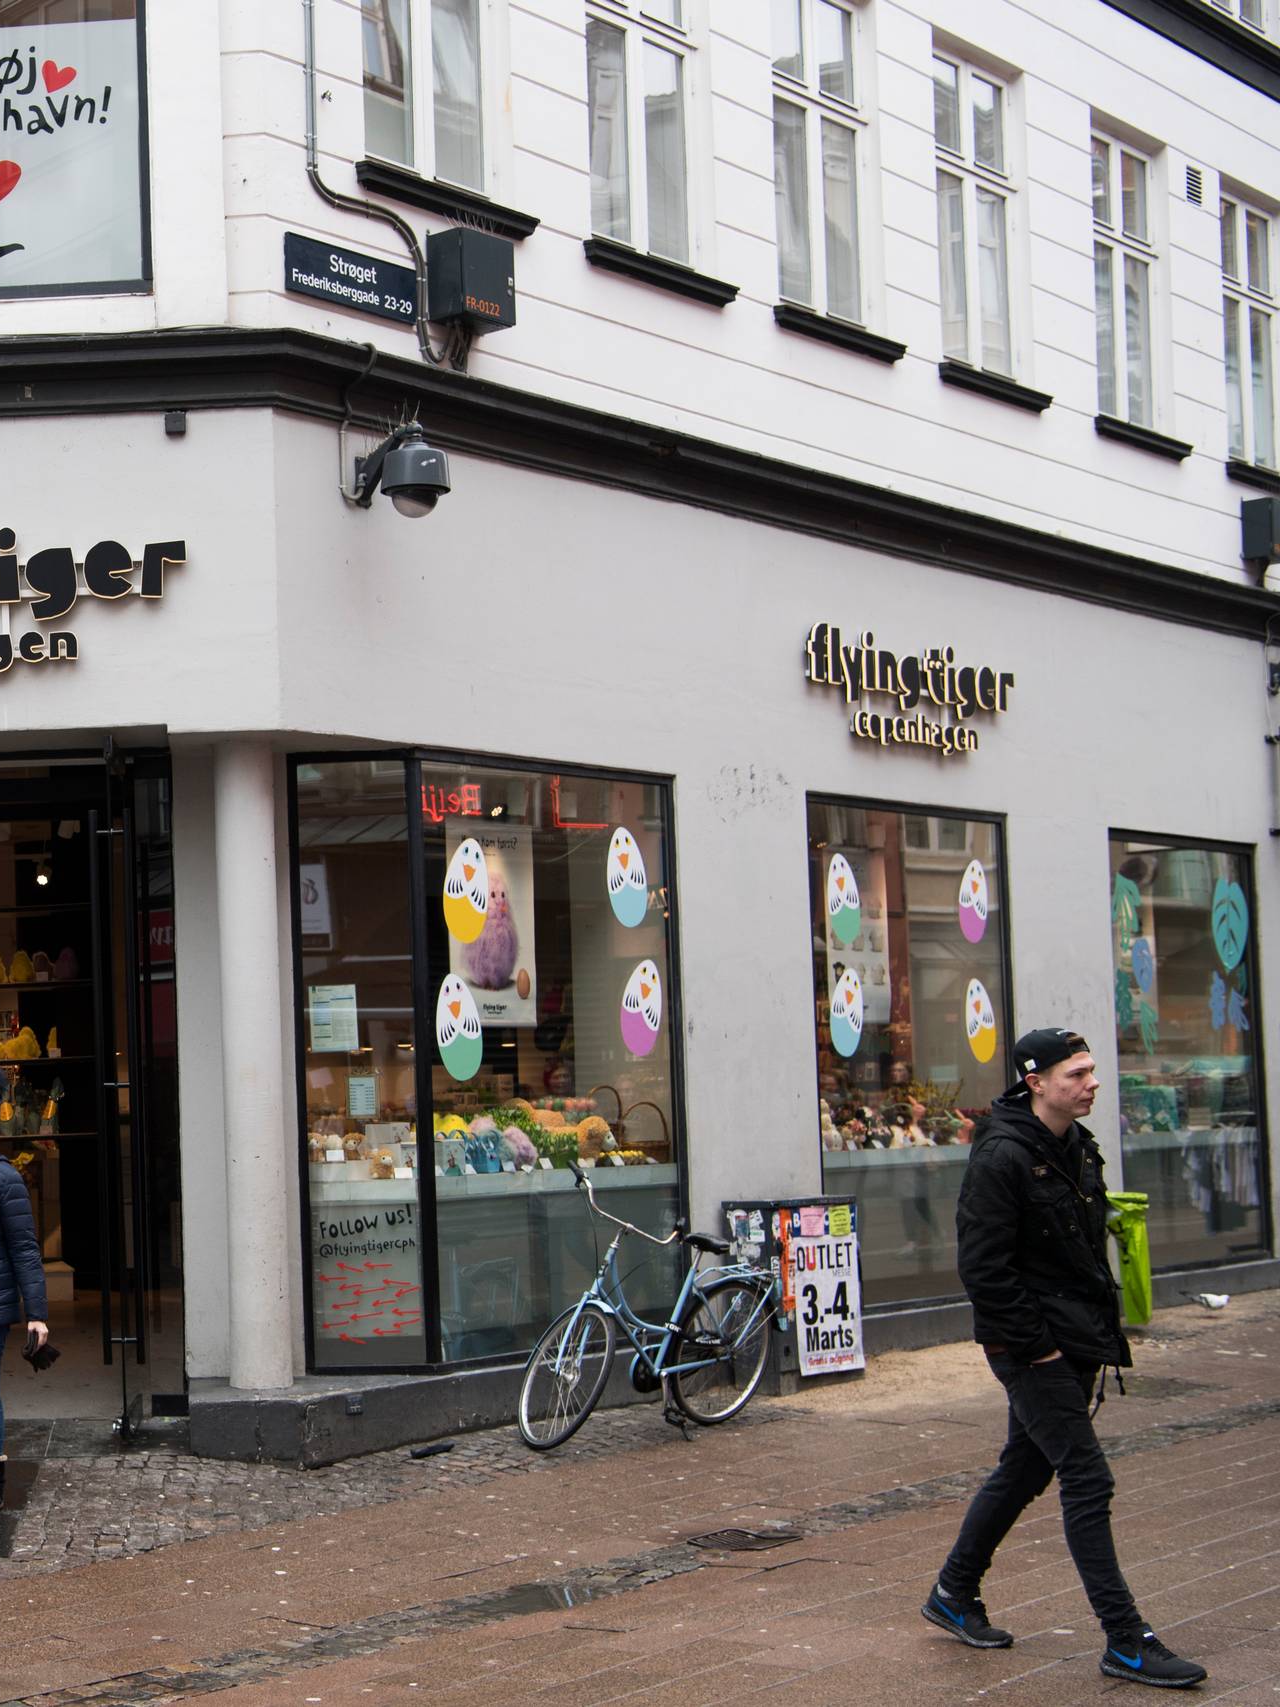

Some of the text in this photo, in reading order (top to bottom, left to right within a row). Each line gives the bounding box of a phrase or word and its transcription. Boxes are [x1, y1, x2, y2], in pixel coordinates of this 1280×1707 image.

[329, 254, 377, 284] Strøget
[292, 268, 413, 315] Frederiksberggade 23-29
[465, 295, 501, 317] FR-0122
[807, 622, 1015, 720] flying tiger
[854, 710, 978, 756] copenhagen
[320, 1238, 416, 1258] @flyingtigercph
[796, 1242, 853, 1272] OUTLET
[802, 1281, 855, 1325] 3.-4.
[806, 1324, 854, 1352] Marts
